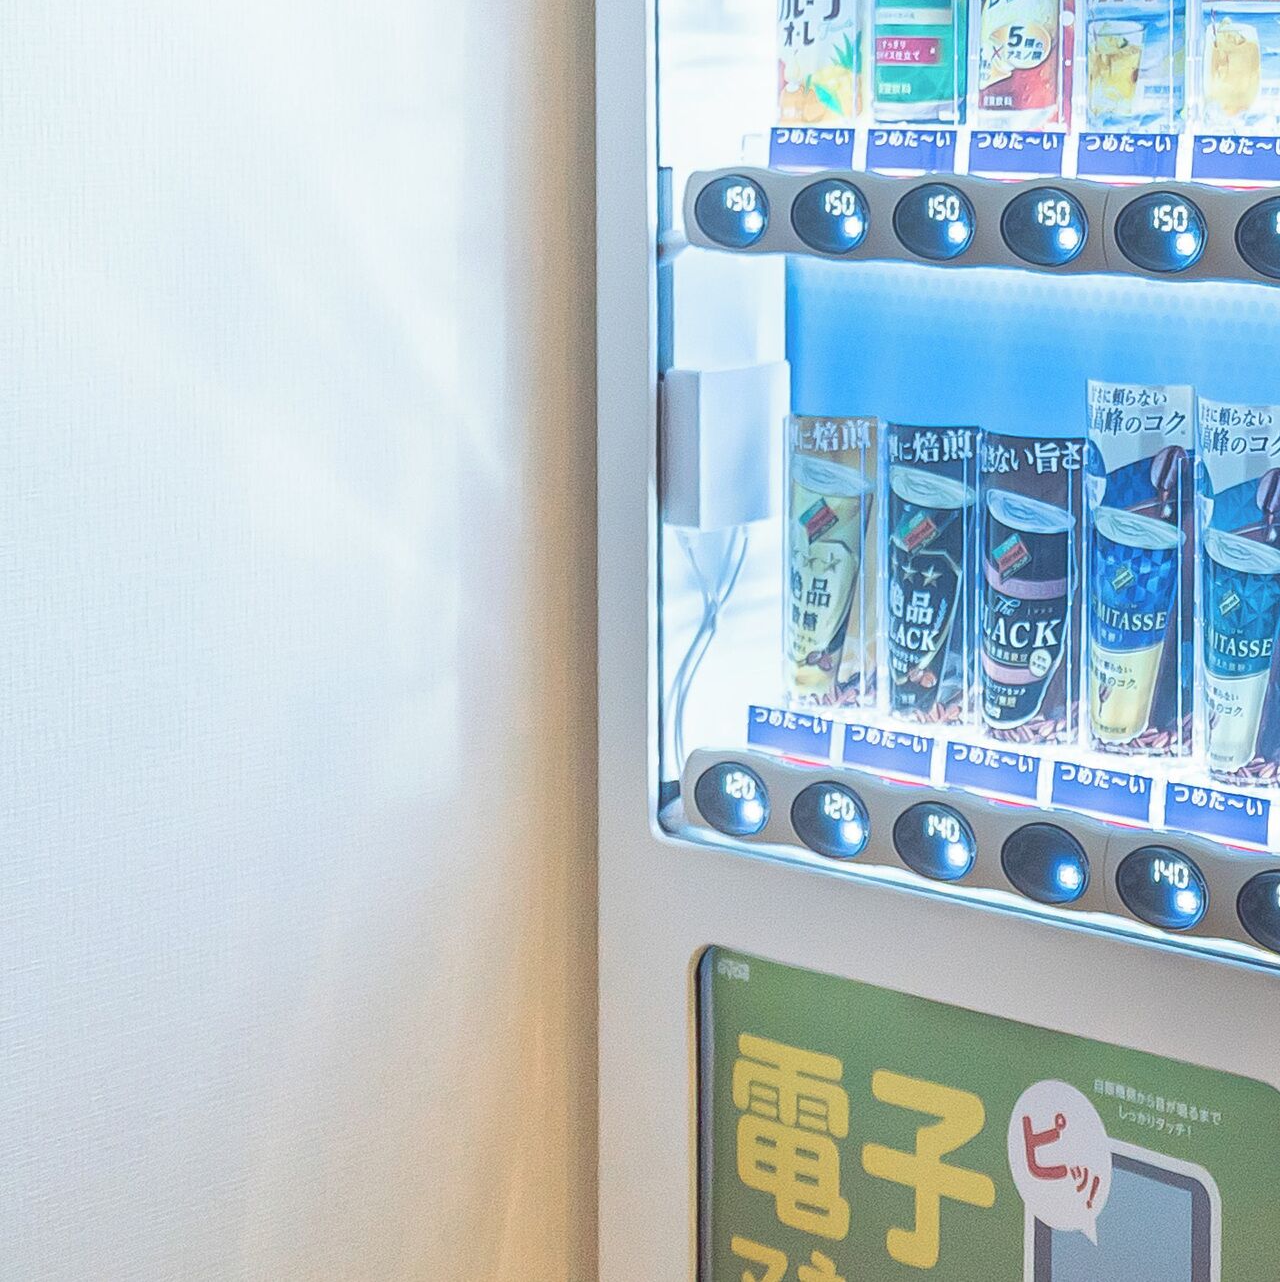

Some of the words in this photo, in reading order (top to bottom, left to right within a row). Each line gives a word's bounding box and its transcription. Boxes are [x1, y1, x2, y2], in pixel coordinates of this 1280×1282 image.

[725, 185, 757, 213] 150
[824, 189, 856, 217] 150
[927, 194, 960, 222] 150
[1036, 199, 1071, 227] 150
[1152, 204, 1189, 233] 150
[725, 771, 757, 800] 120
[823, 791, 855, 822] 120
[927, 813, 960, 845] 140
[1153, 857, 1190, 889] 140
[731, 1033, 996, 1270] 電子
[1022, 1112, 1100, 1210] ピッ!
